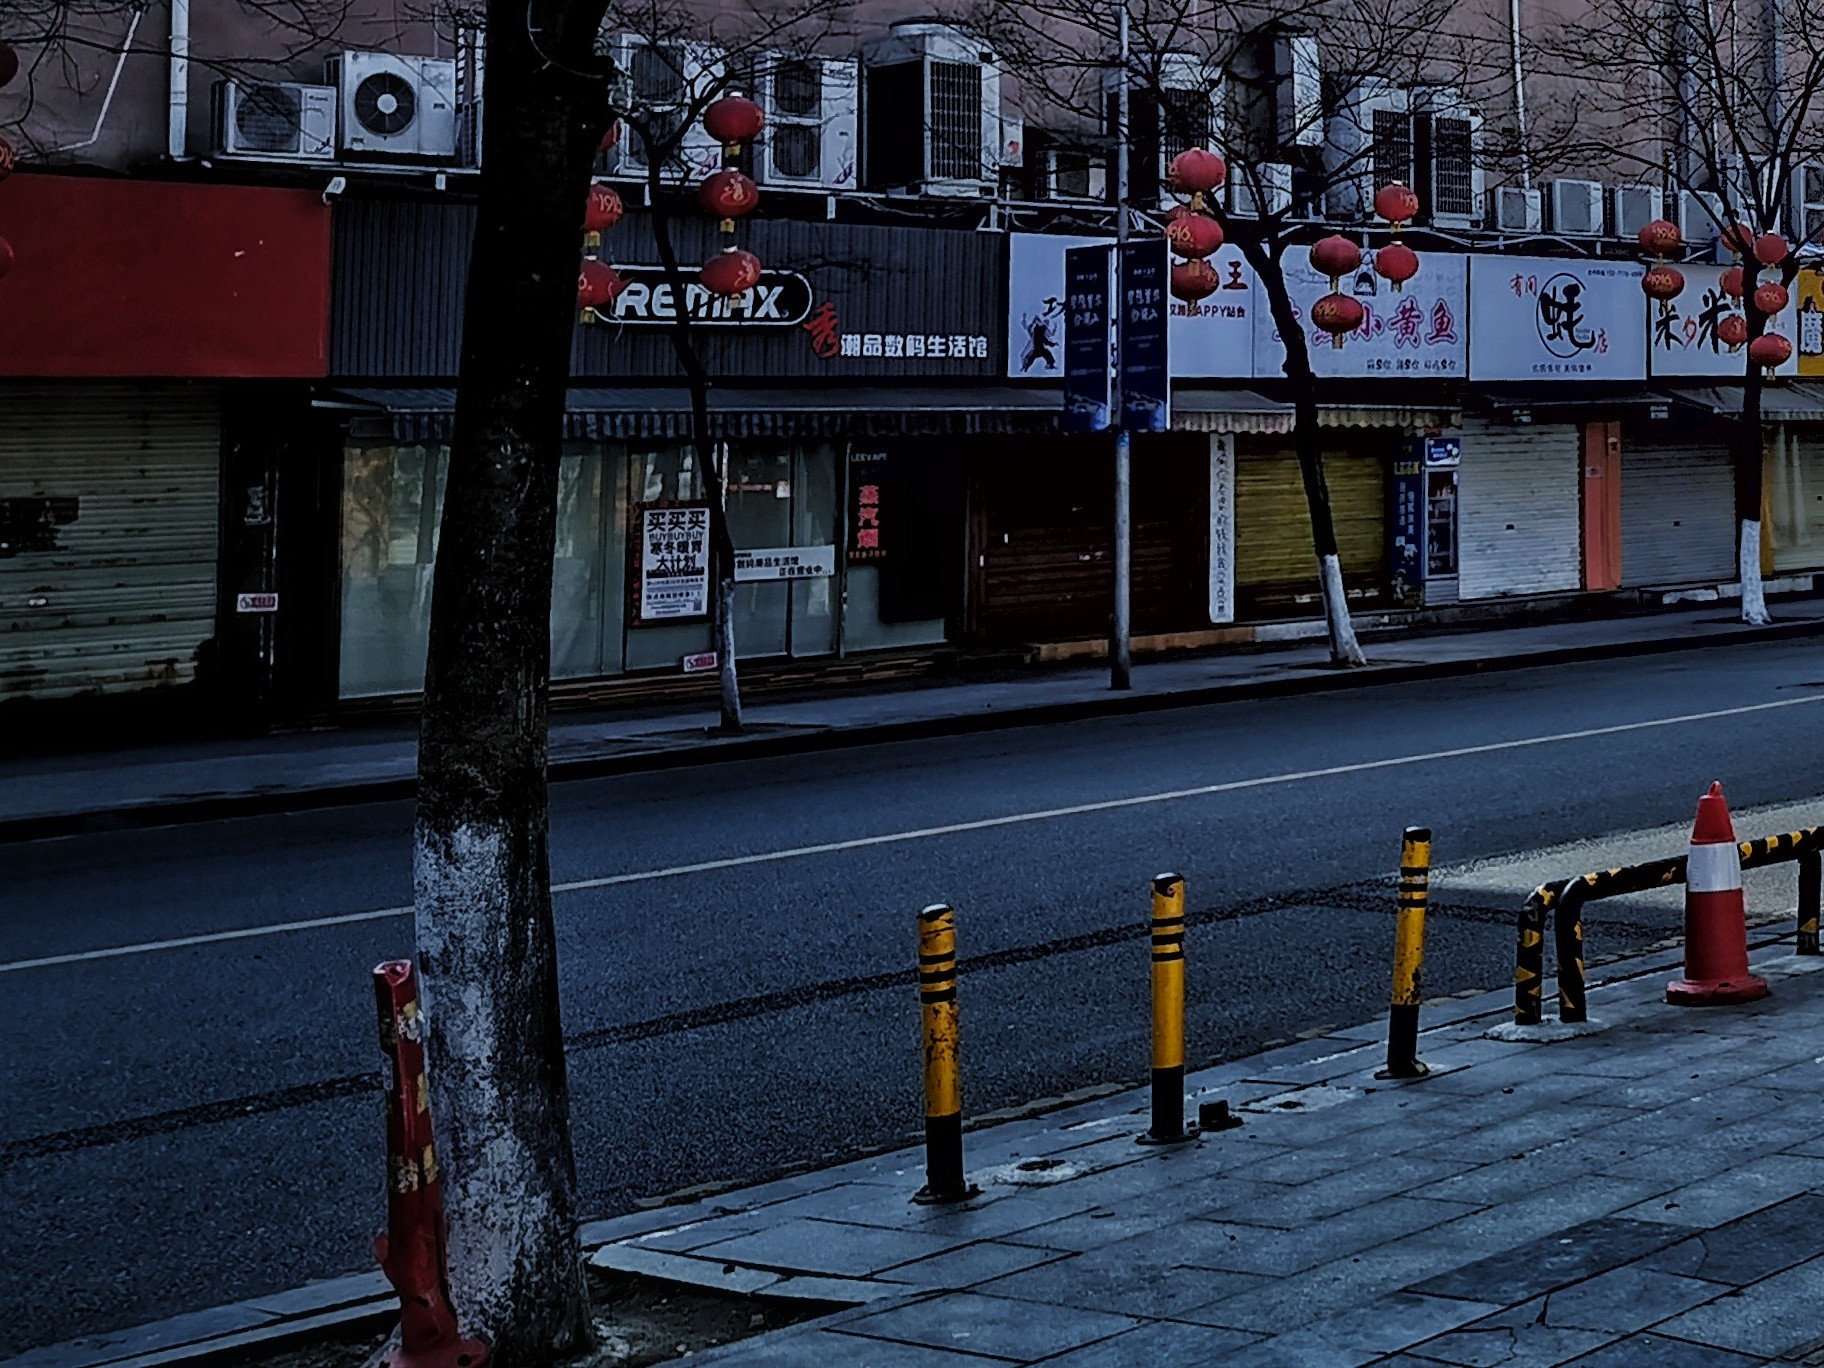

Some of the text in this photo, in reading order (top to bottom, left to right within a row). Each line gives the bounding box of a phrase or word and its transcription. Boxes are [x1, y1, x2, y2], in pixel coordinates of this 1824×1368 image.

[840, 334, 988, 358] 潮品数码生活馆
[646, 510, 706, 533] 买买买
